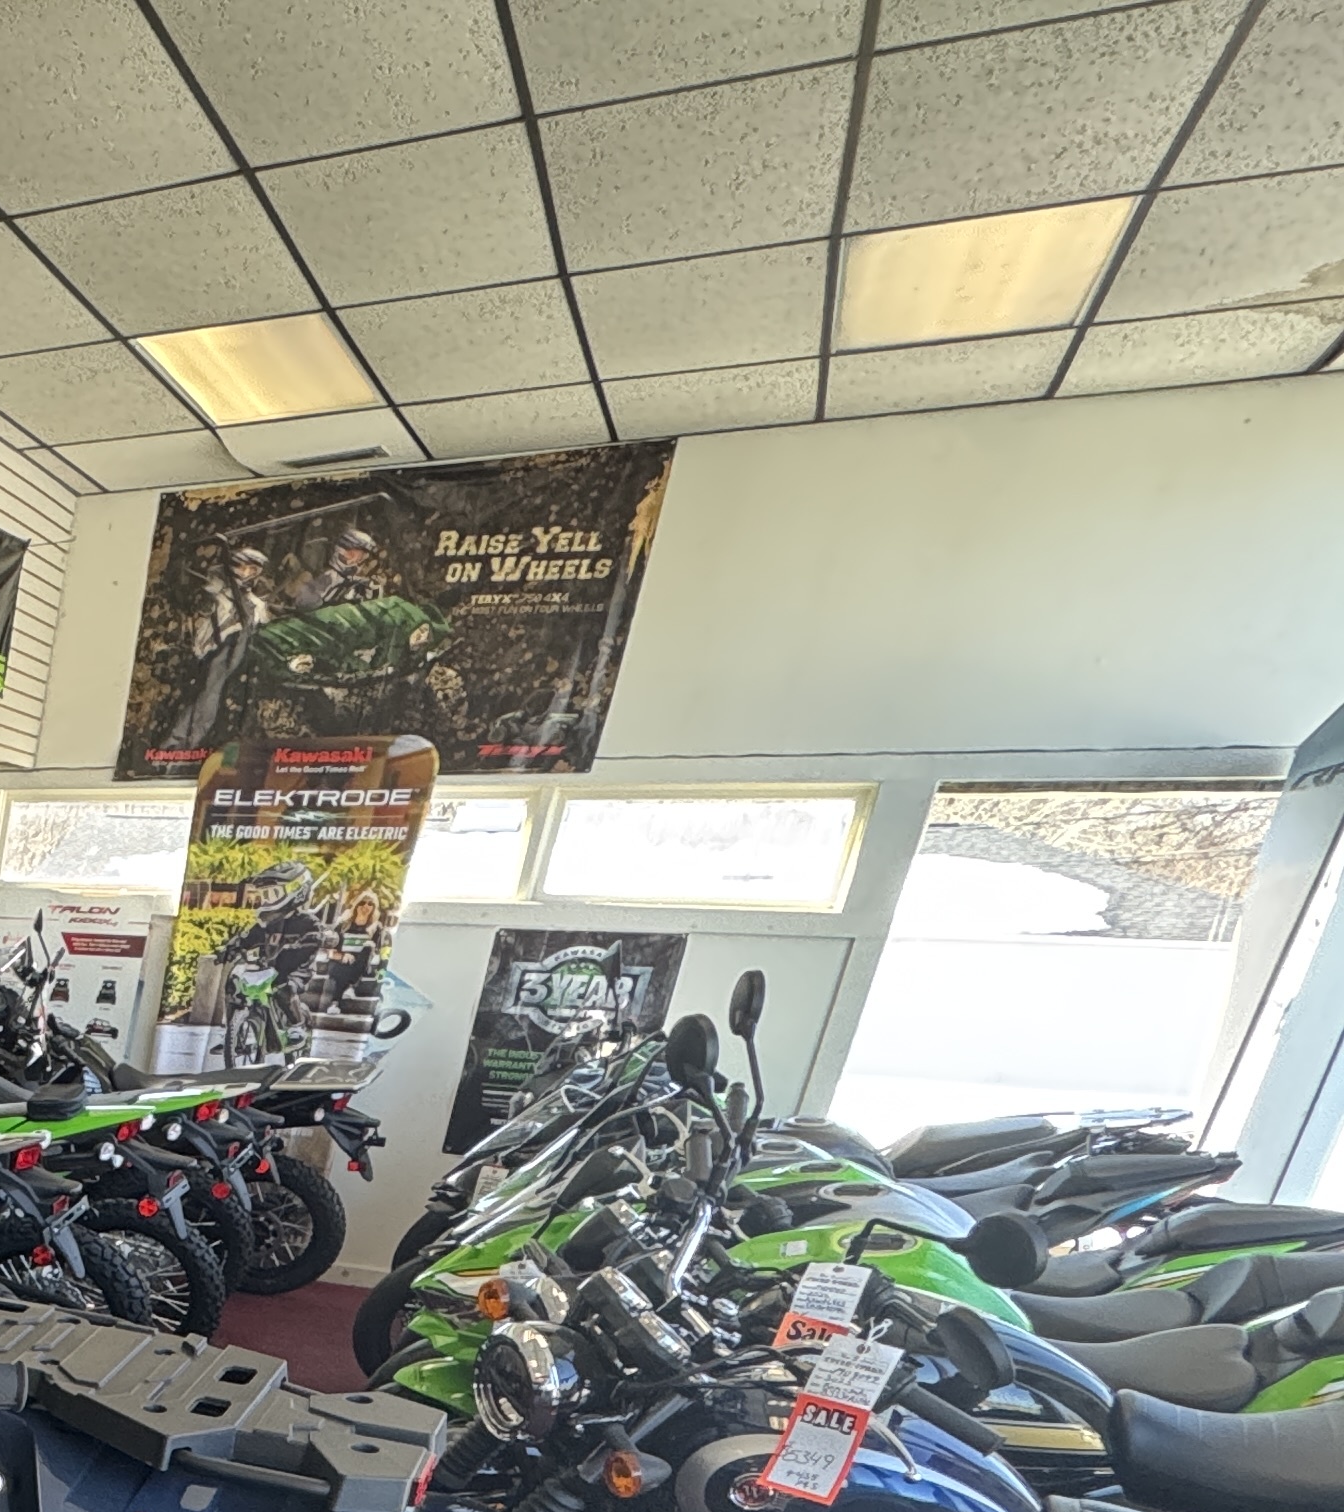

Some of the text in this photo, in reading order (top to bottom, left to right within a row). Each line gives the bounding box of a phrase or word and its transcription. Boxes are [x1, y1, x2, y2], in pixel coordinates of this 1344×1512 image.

[274, 746, 373, 764] Kawasaki
[214, 787, 413, 807] ELEKTRODE
[211, 825, 233, 839] THE
[235, 825, 269, 840] GOOD
[318, 825, 344, 840] ARE
[346, 825, 408, 841] ELECTRIC
[47, 905, 120, 915] TALON
[519, 972, 634, 1010] 3 YEAR
[802, 1401, 857, 1435] SALE
